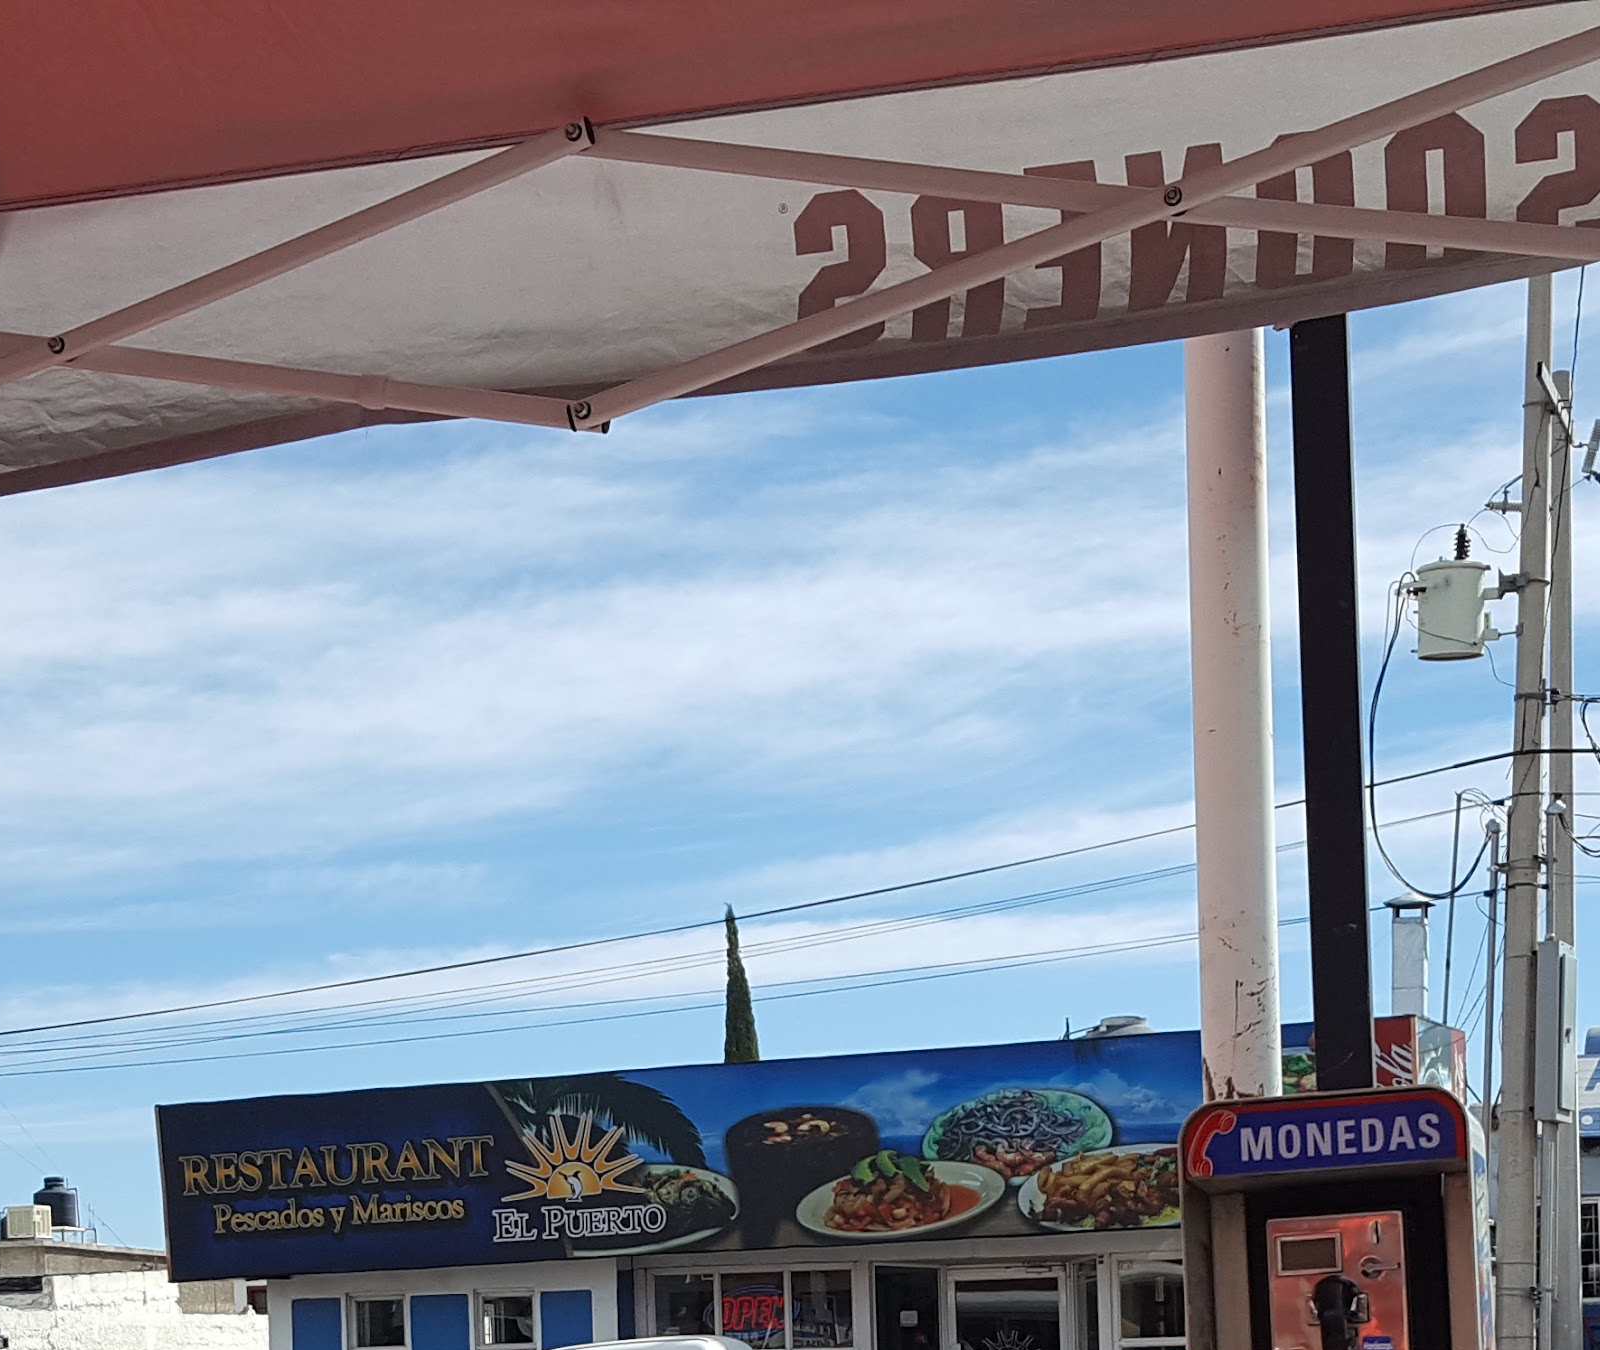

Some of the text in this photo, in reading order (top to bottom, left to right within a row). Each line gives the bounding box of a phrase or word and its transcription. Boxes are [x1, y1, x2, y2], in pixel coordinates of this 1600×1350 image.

[1239, 1112, 1441, 1162] MONEDAS
[178, 1134, 494, 1196] RESTAURANT
[213, 1193, 465, 1234] Pescados y Mariscos
[722, 1295, 786, 1331] OPEN
